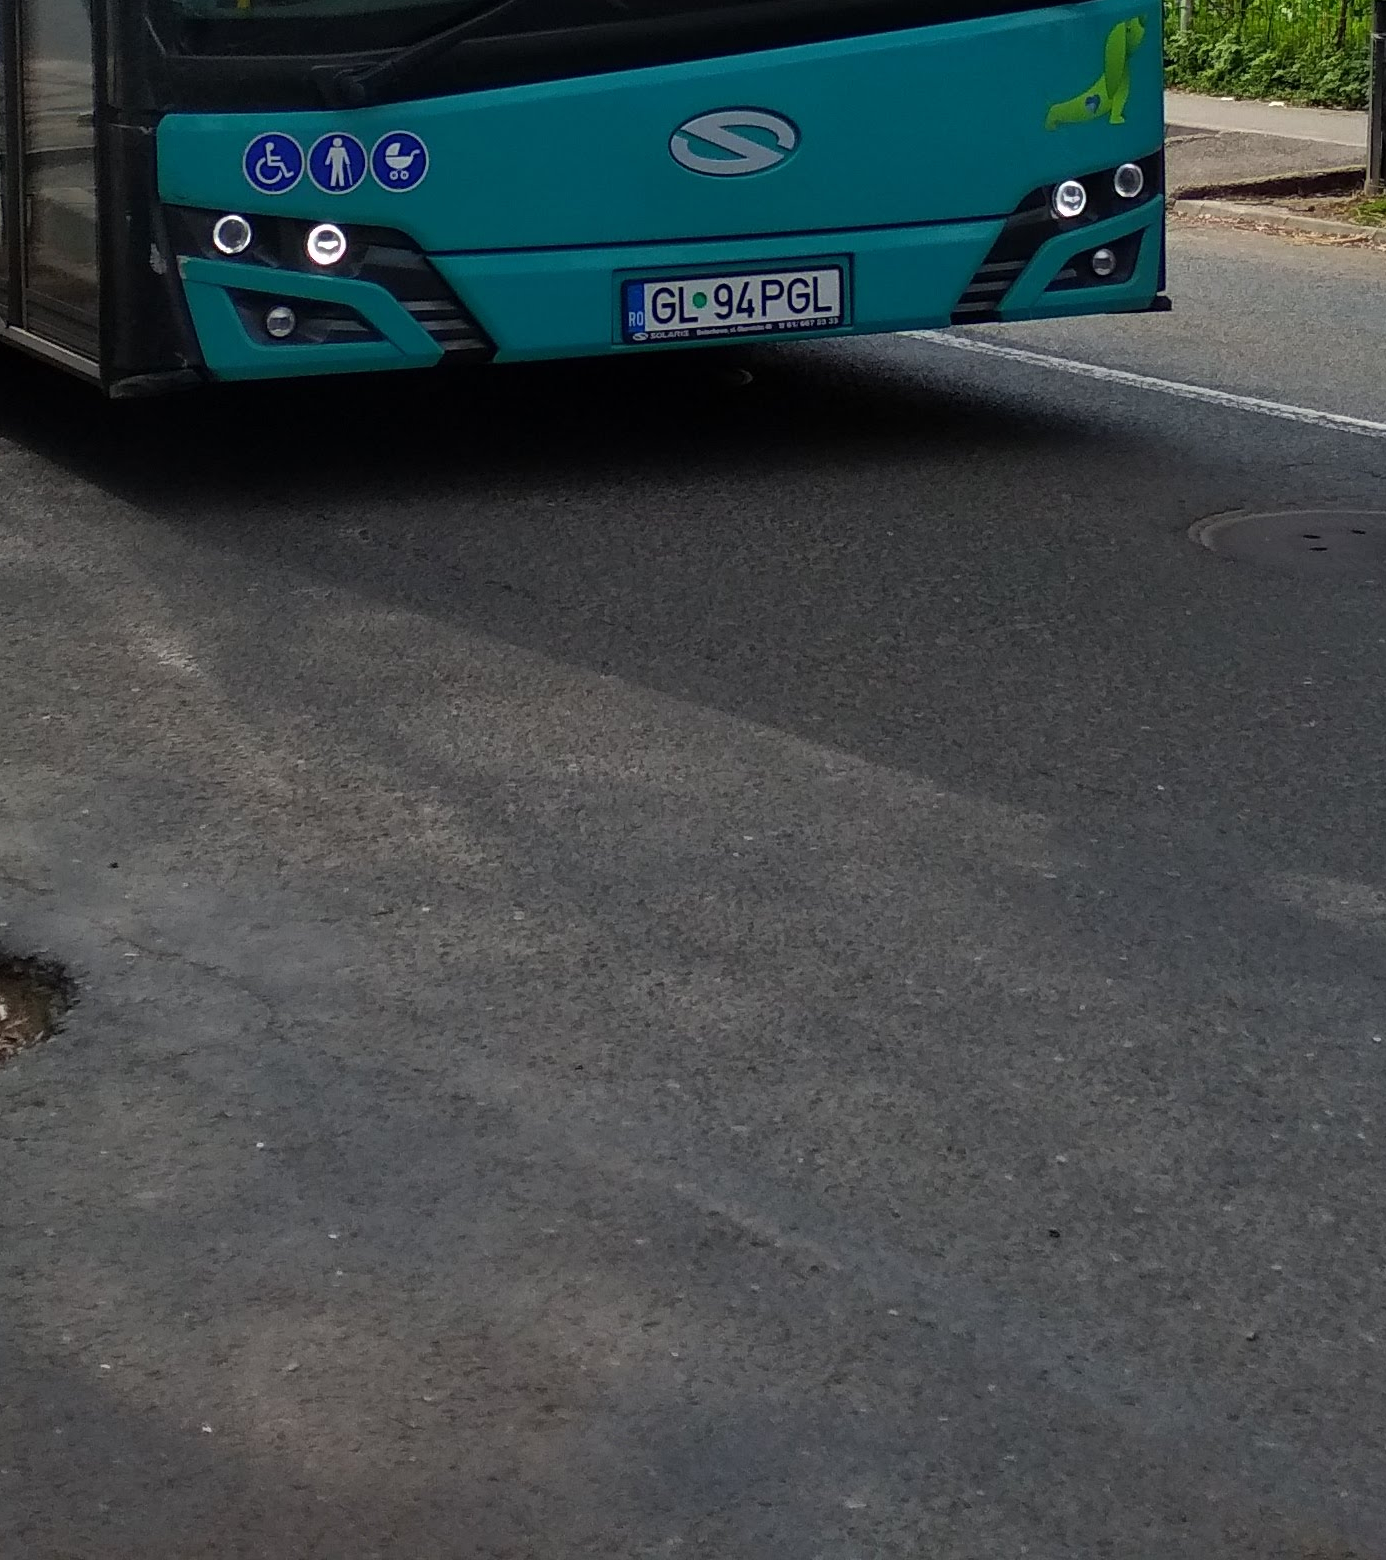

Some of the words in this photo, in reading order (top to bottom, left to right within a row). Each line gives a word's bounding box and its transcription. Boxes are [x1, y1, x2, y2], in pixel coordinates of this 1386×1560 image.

[651, 287, 699, 324] GL
[714, 281, 755, 320] 94
[761, 277, 833, 317] PGL
[628, 311, 644, 327] RO
